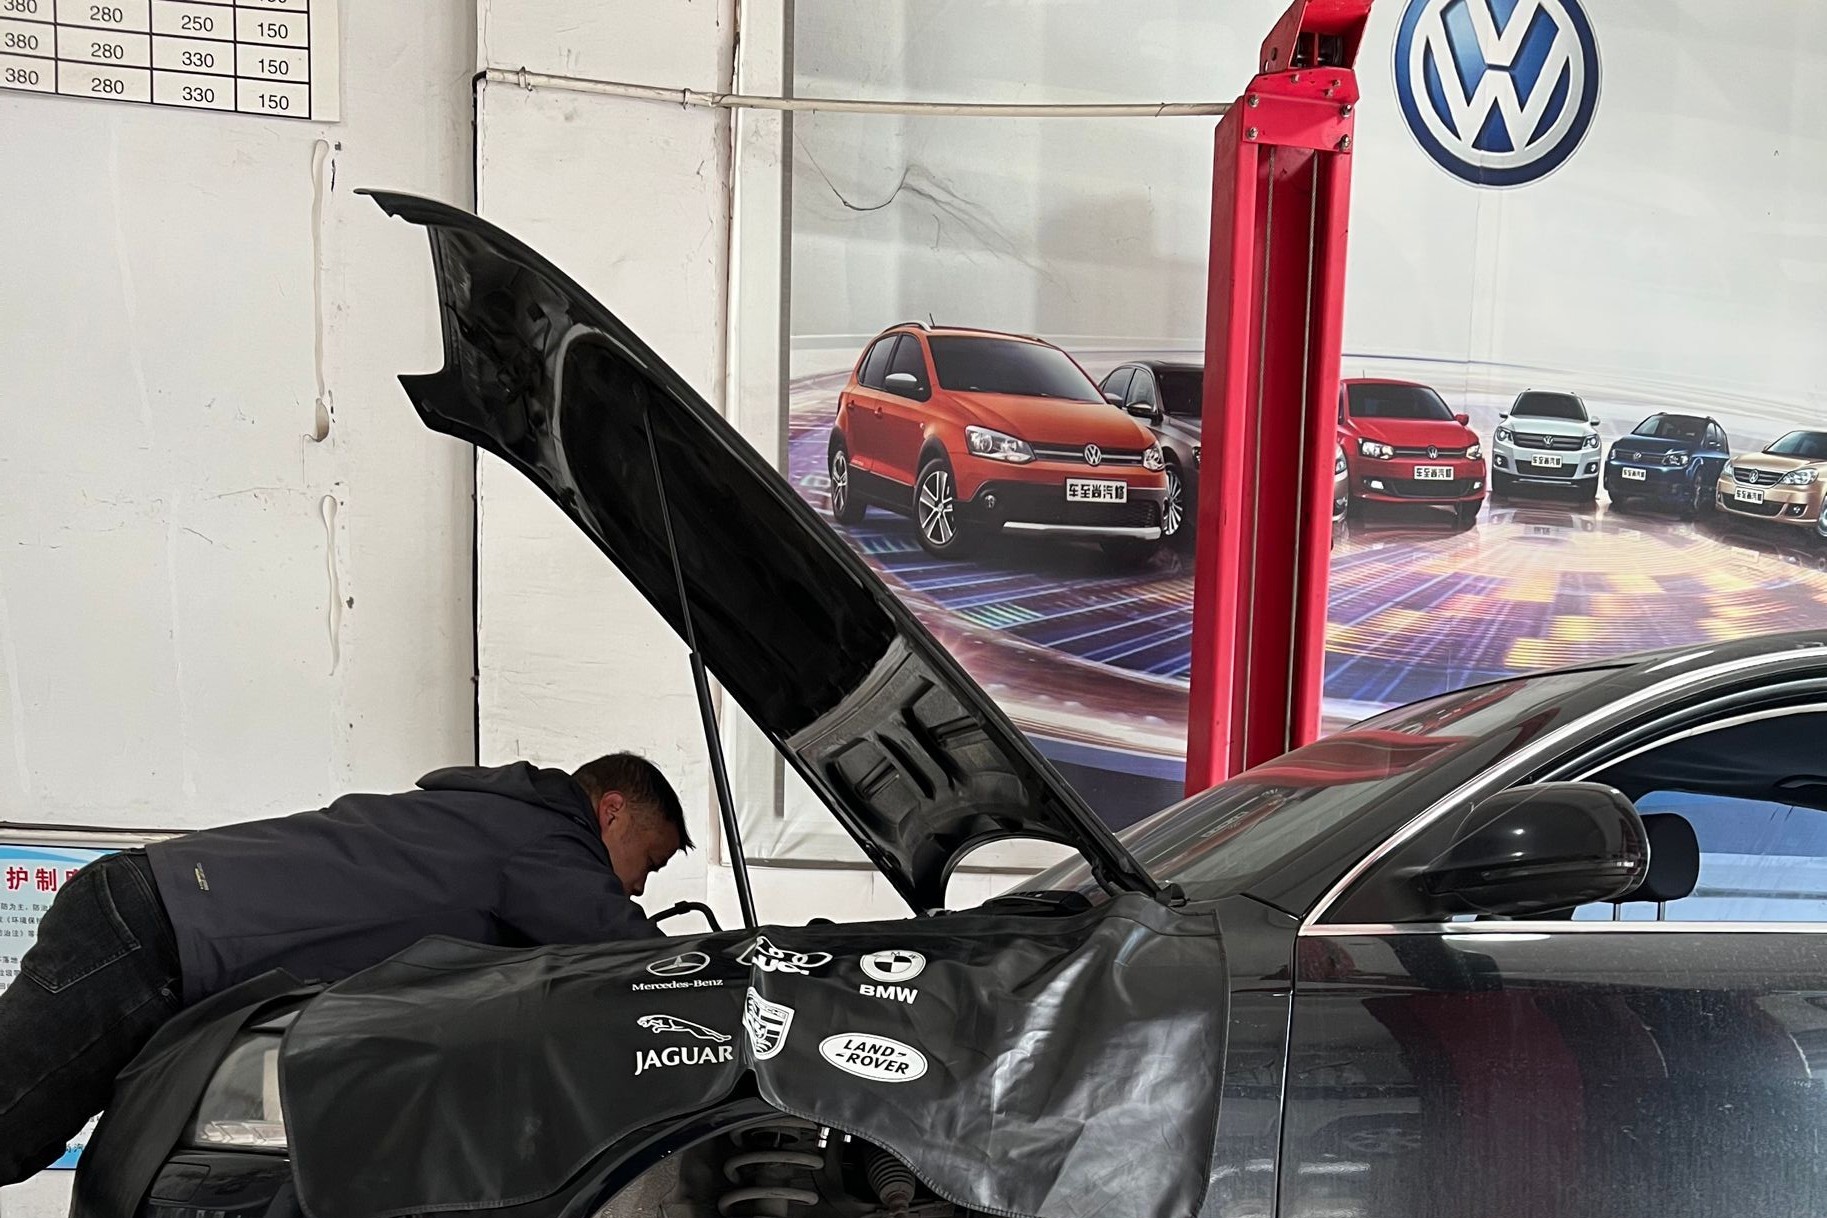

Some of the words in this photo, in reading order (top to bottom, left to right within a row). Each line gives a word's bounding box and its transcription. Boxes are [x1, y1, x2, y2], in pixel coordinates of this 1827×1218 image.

[4, 0, 38, 14] 380
[89, 5, 123, 23] 280
[181, 14, 214, 32] 250
[257, 22, 288, 39] 150
[4, 32, 39, 50] 380
[90, 42, 124, 60] 280
[181, 51, 215, 68] 330
[258, 58, 289, 75] 150
[5, 67, 39, 85] 380
[91, 77, 124, 94] 280
[182, 86, 215, 103] 330
[259, 94, 290, 110] 150
[632, 979, 724, 992] Mercedes-Benz
[859, 983, 919, 1005] BMW
[634, 1045, 734, 1076] JAGUAR
